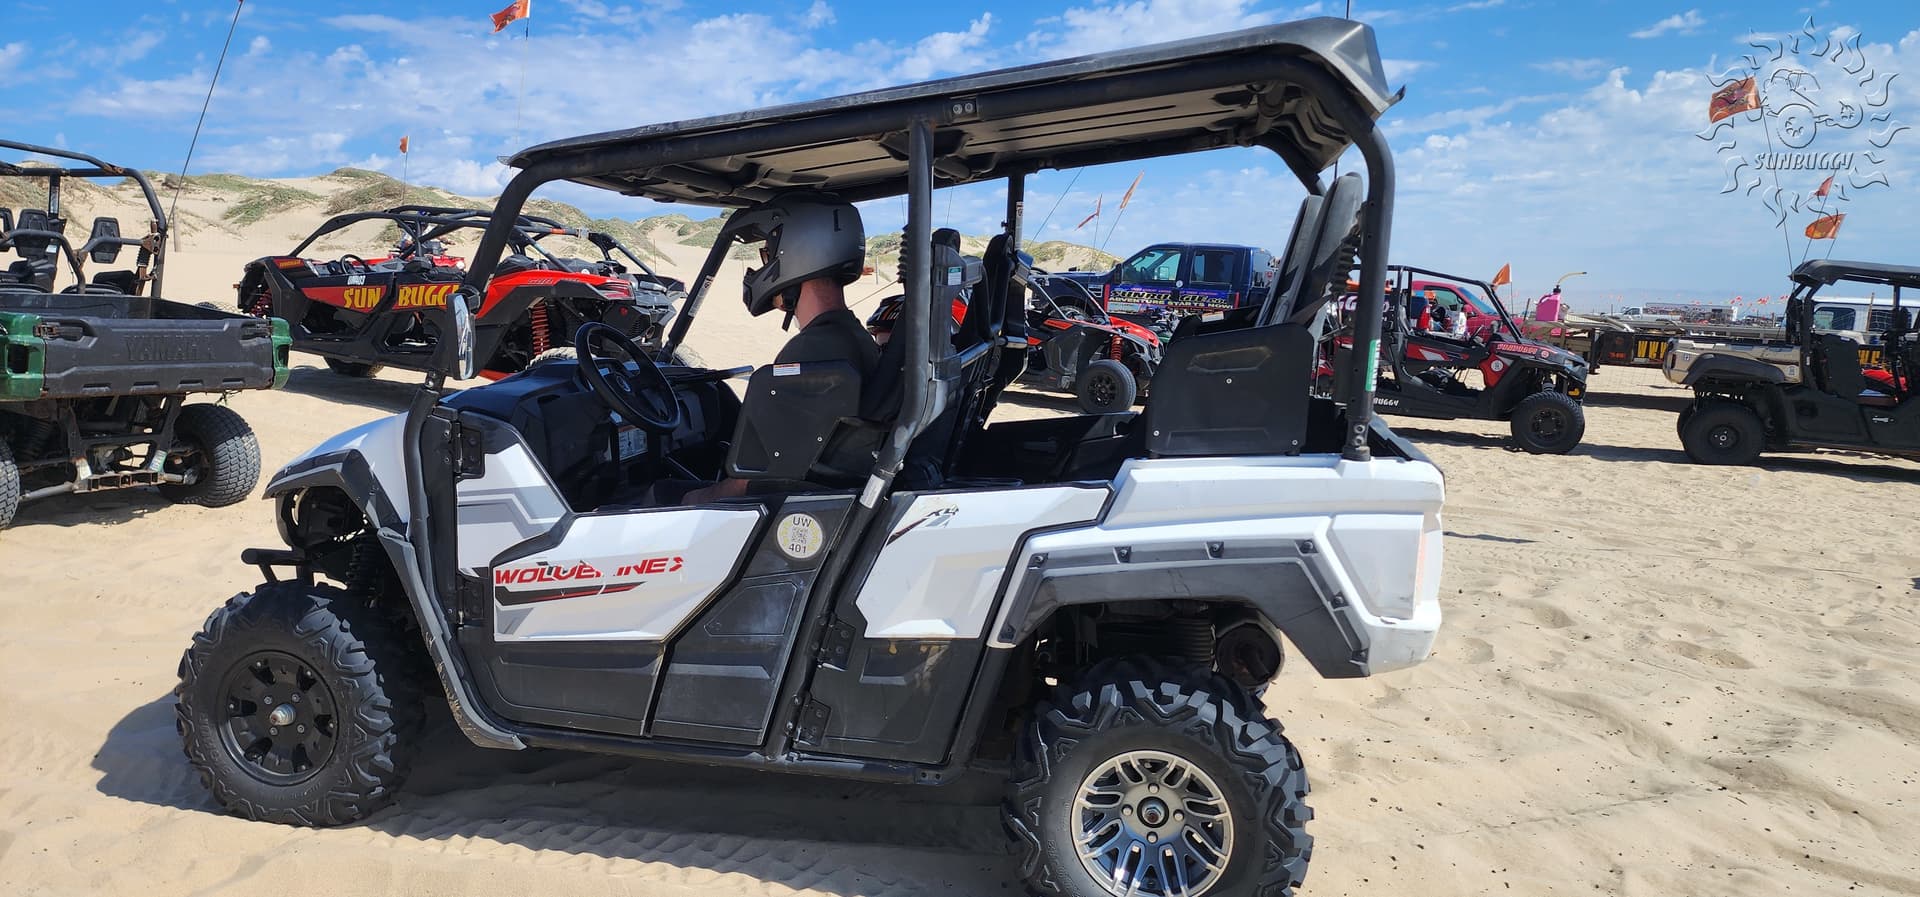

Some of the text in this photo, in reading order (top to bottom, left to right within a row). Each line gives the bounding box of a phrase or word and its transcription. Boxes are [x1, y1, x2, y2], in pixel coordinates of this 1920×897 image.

[344, 286, 460, 308] SUN BUGG
[1109, 296, 1165, 305] ADVENTURE
[123, 335, 216, 361] YAMAHA
[792, 516, 812, 527] UW
[789, 543, 806, 554] 401
